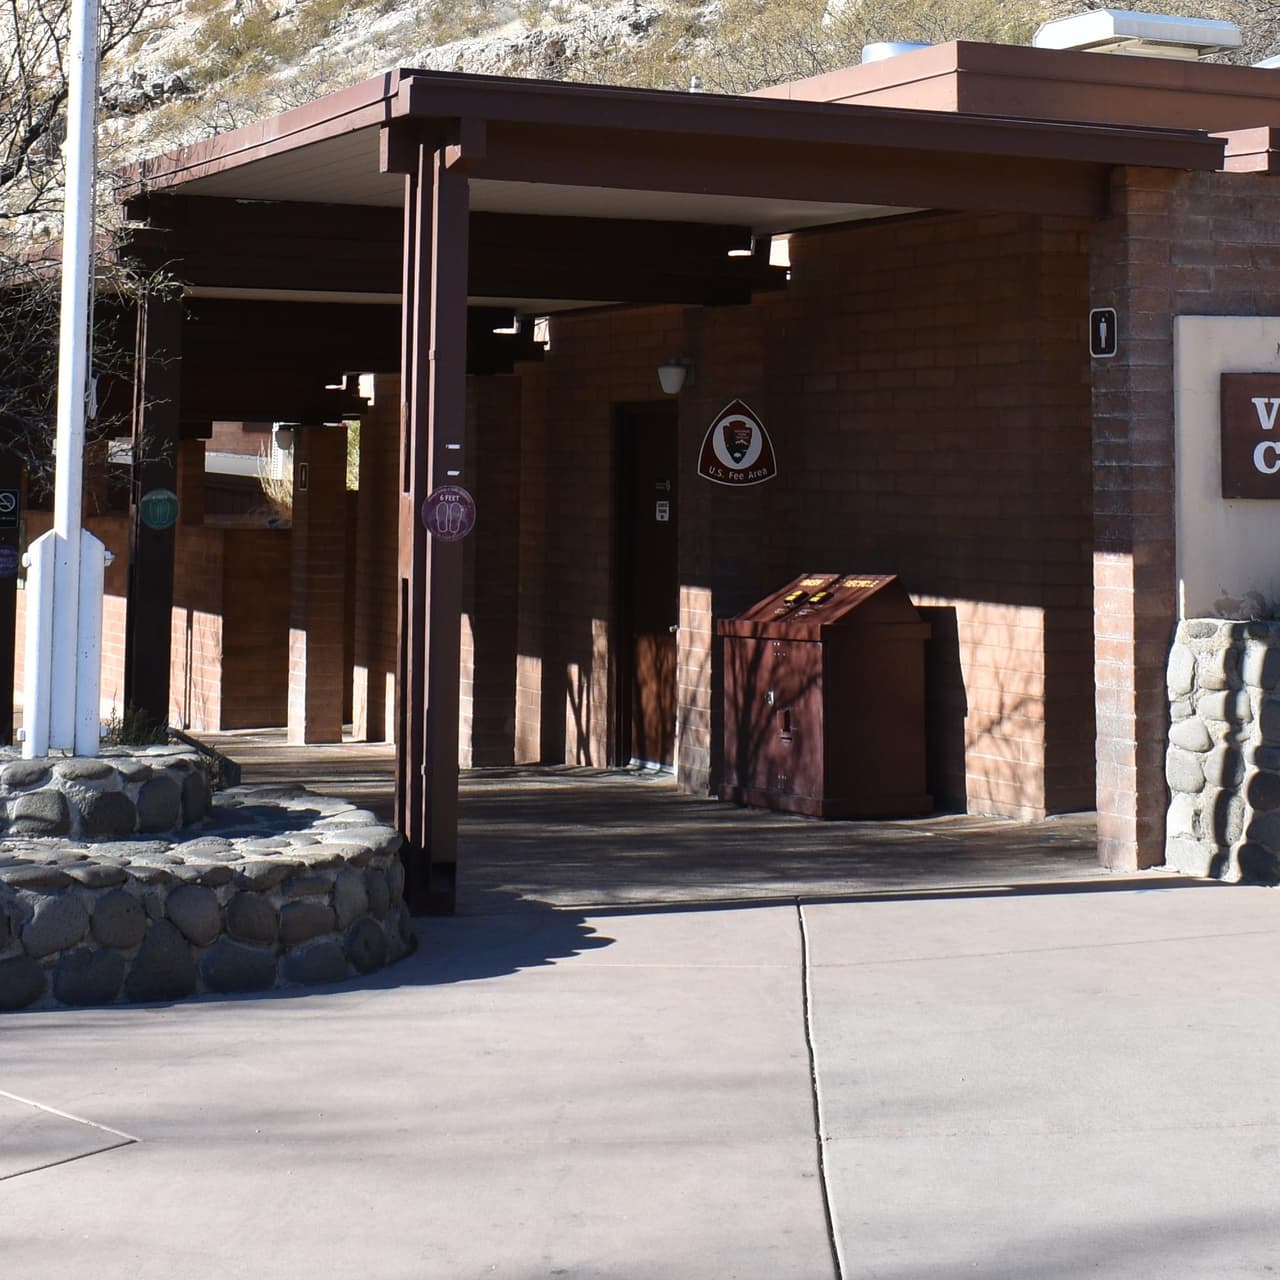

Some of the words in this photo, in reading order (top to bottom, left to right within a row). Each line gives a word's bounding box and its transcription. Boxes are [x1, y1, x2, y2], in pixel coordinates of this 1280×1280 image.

[709, 465, 725, 478] U.S.
[729, 471, 744, 480] Fee
[748, 467, 768, 479] Area
